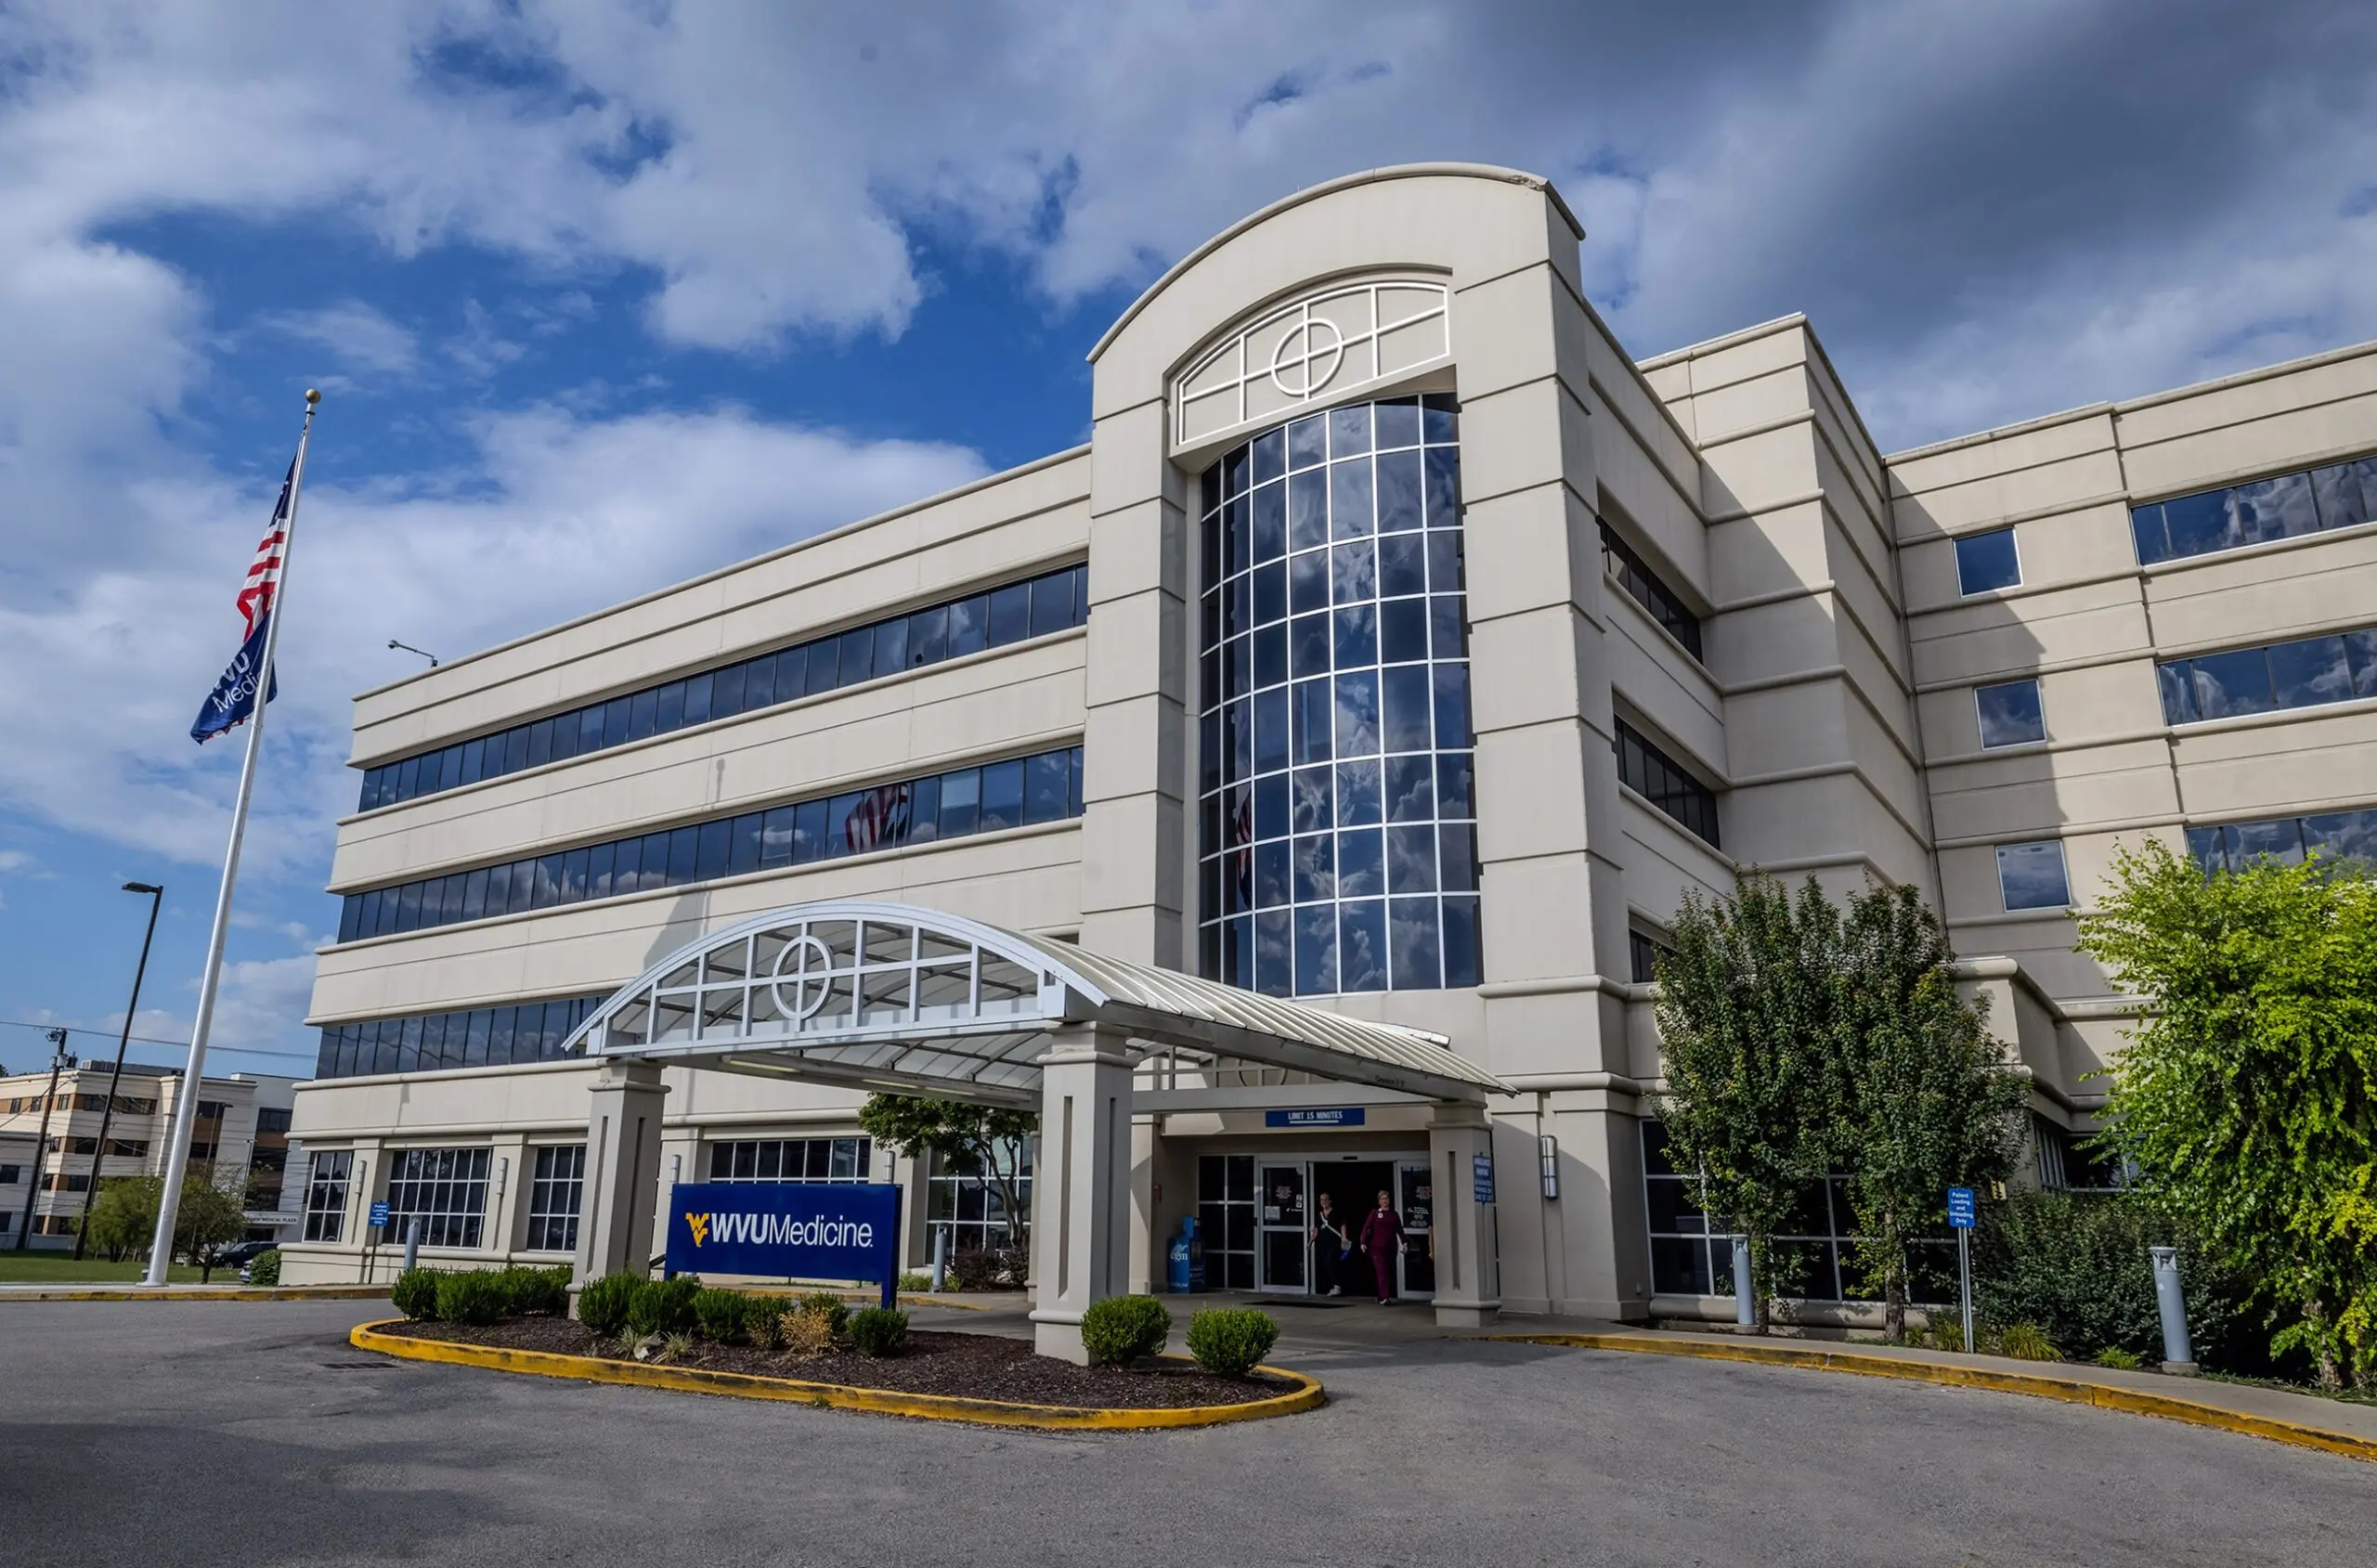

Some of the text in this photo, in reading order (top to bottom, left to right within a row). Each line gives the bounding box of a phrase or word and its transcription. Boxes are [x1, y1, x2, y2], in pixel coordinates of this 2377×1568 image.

[214, 652, 251, 690] VU
[1288, 1110, 1344, 1121] LIMIT 15 MINUTES
